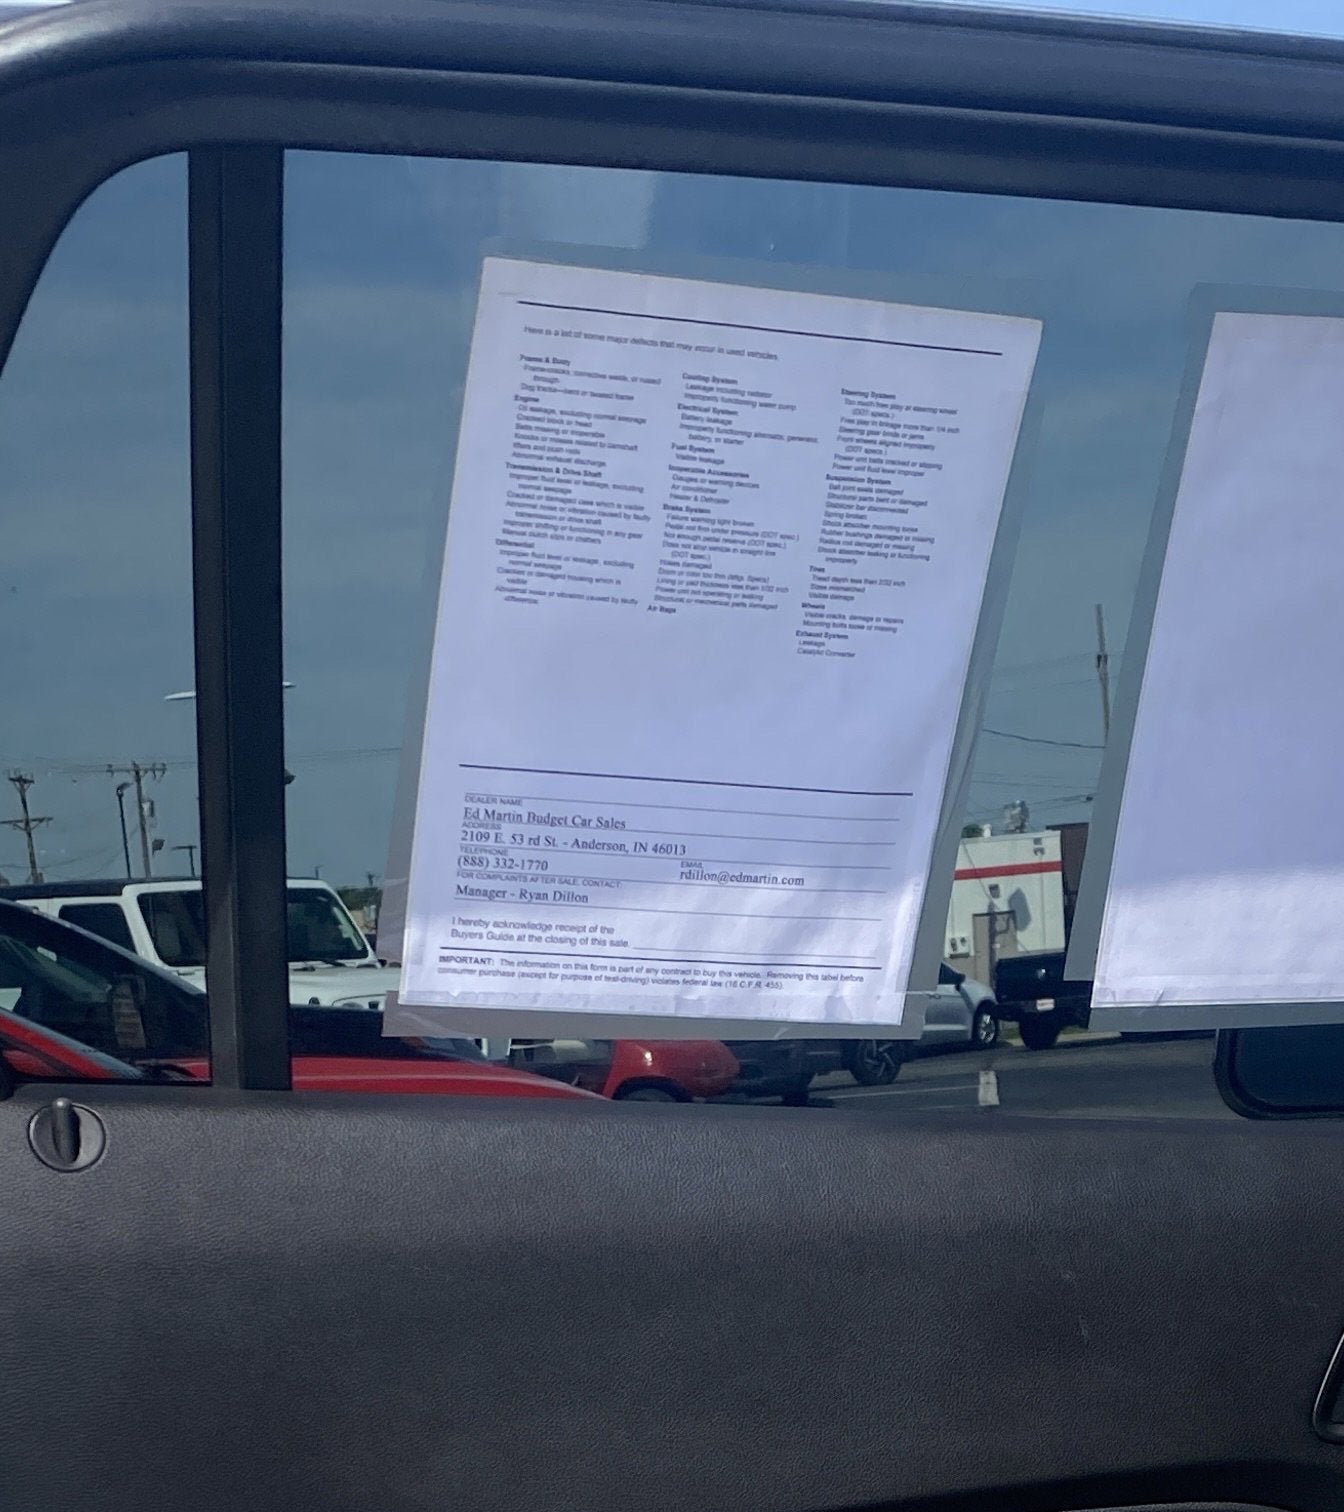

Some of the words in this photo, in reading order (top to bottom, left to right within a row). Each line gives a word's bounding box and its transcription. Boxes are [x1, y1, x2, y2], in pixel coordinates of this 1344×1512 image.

[464, 794, 498, 804] DEALER
[499, 797, 522, 806] NAME
[463, 806, 480, 819] Ed
[483, 807, 523, 822] Martin
[526, 810, 568, 825] Budget
[570, 814, 593, 826] Car
[595, 815, 626, 828] Sales
[460, 829, 491, 843] 2109
[509, 832, 524, 845] 53
[527, 834, 541, 846] rd
[570, 837, 629, 852] Anderson,
[632, 840, 648, 853] IN
[650, 842, 686, 855] 46013
[456, 854, 490, 870] (888)
[492, 856, 549, 871] 332-1770
[679, 868, 805, 886] rdillon@edmartin.com
[455, 883, 508, 900] Manager
[518, 887, 549, 902] Ryan
[551, 889, 589, 904] Dillon
[457, 916, 490, 929] hereby
[491, 919, 553, 933] acknowledge
[554, 923, 587, 934] receipt
[599, 925, 615, 935] the
[450, 927, 484, 940] Buyers
[485, 930, 514, 941] Guide
[527, 933, 543, 943] the
[543, 934, 577, 947] closing
[590, 937, 607, 947] this
[499, 957, 515, 967] The
[515, 959, 560, 969] information
[573, 962, 588, 970] this
[589, 962, 608, 971] form
[617, 965, 634, 973] part
[644, 967, 659, 975] any
[660, 967, 692, 976] contract
[701, 968, 717, 978] buy
[717, 969, 732, 978] this
[765, 970, 804, 982] Removing
[804, 972, 819, 981] this
[820, 973, 839, 981] label
[839, 973, 864, 982] before
